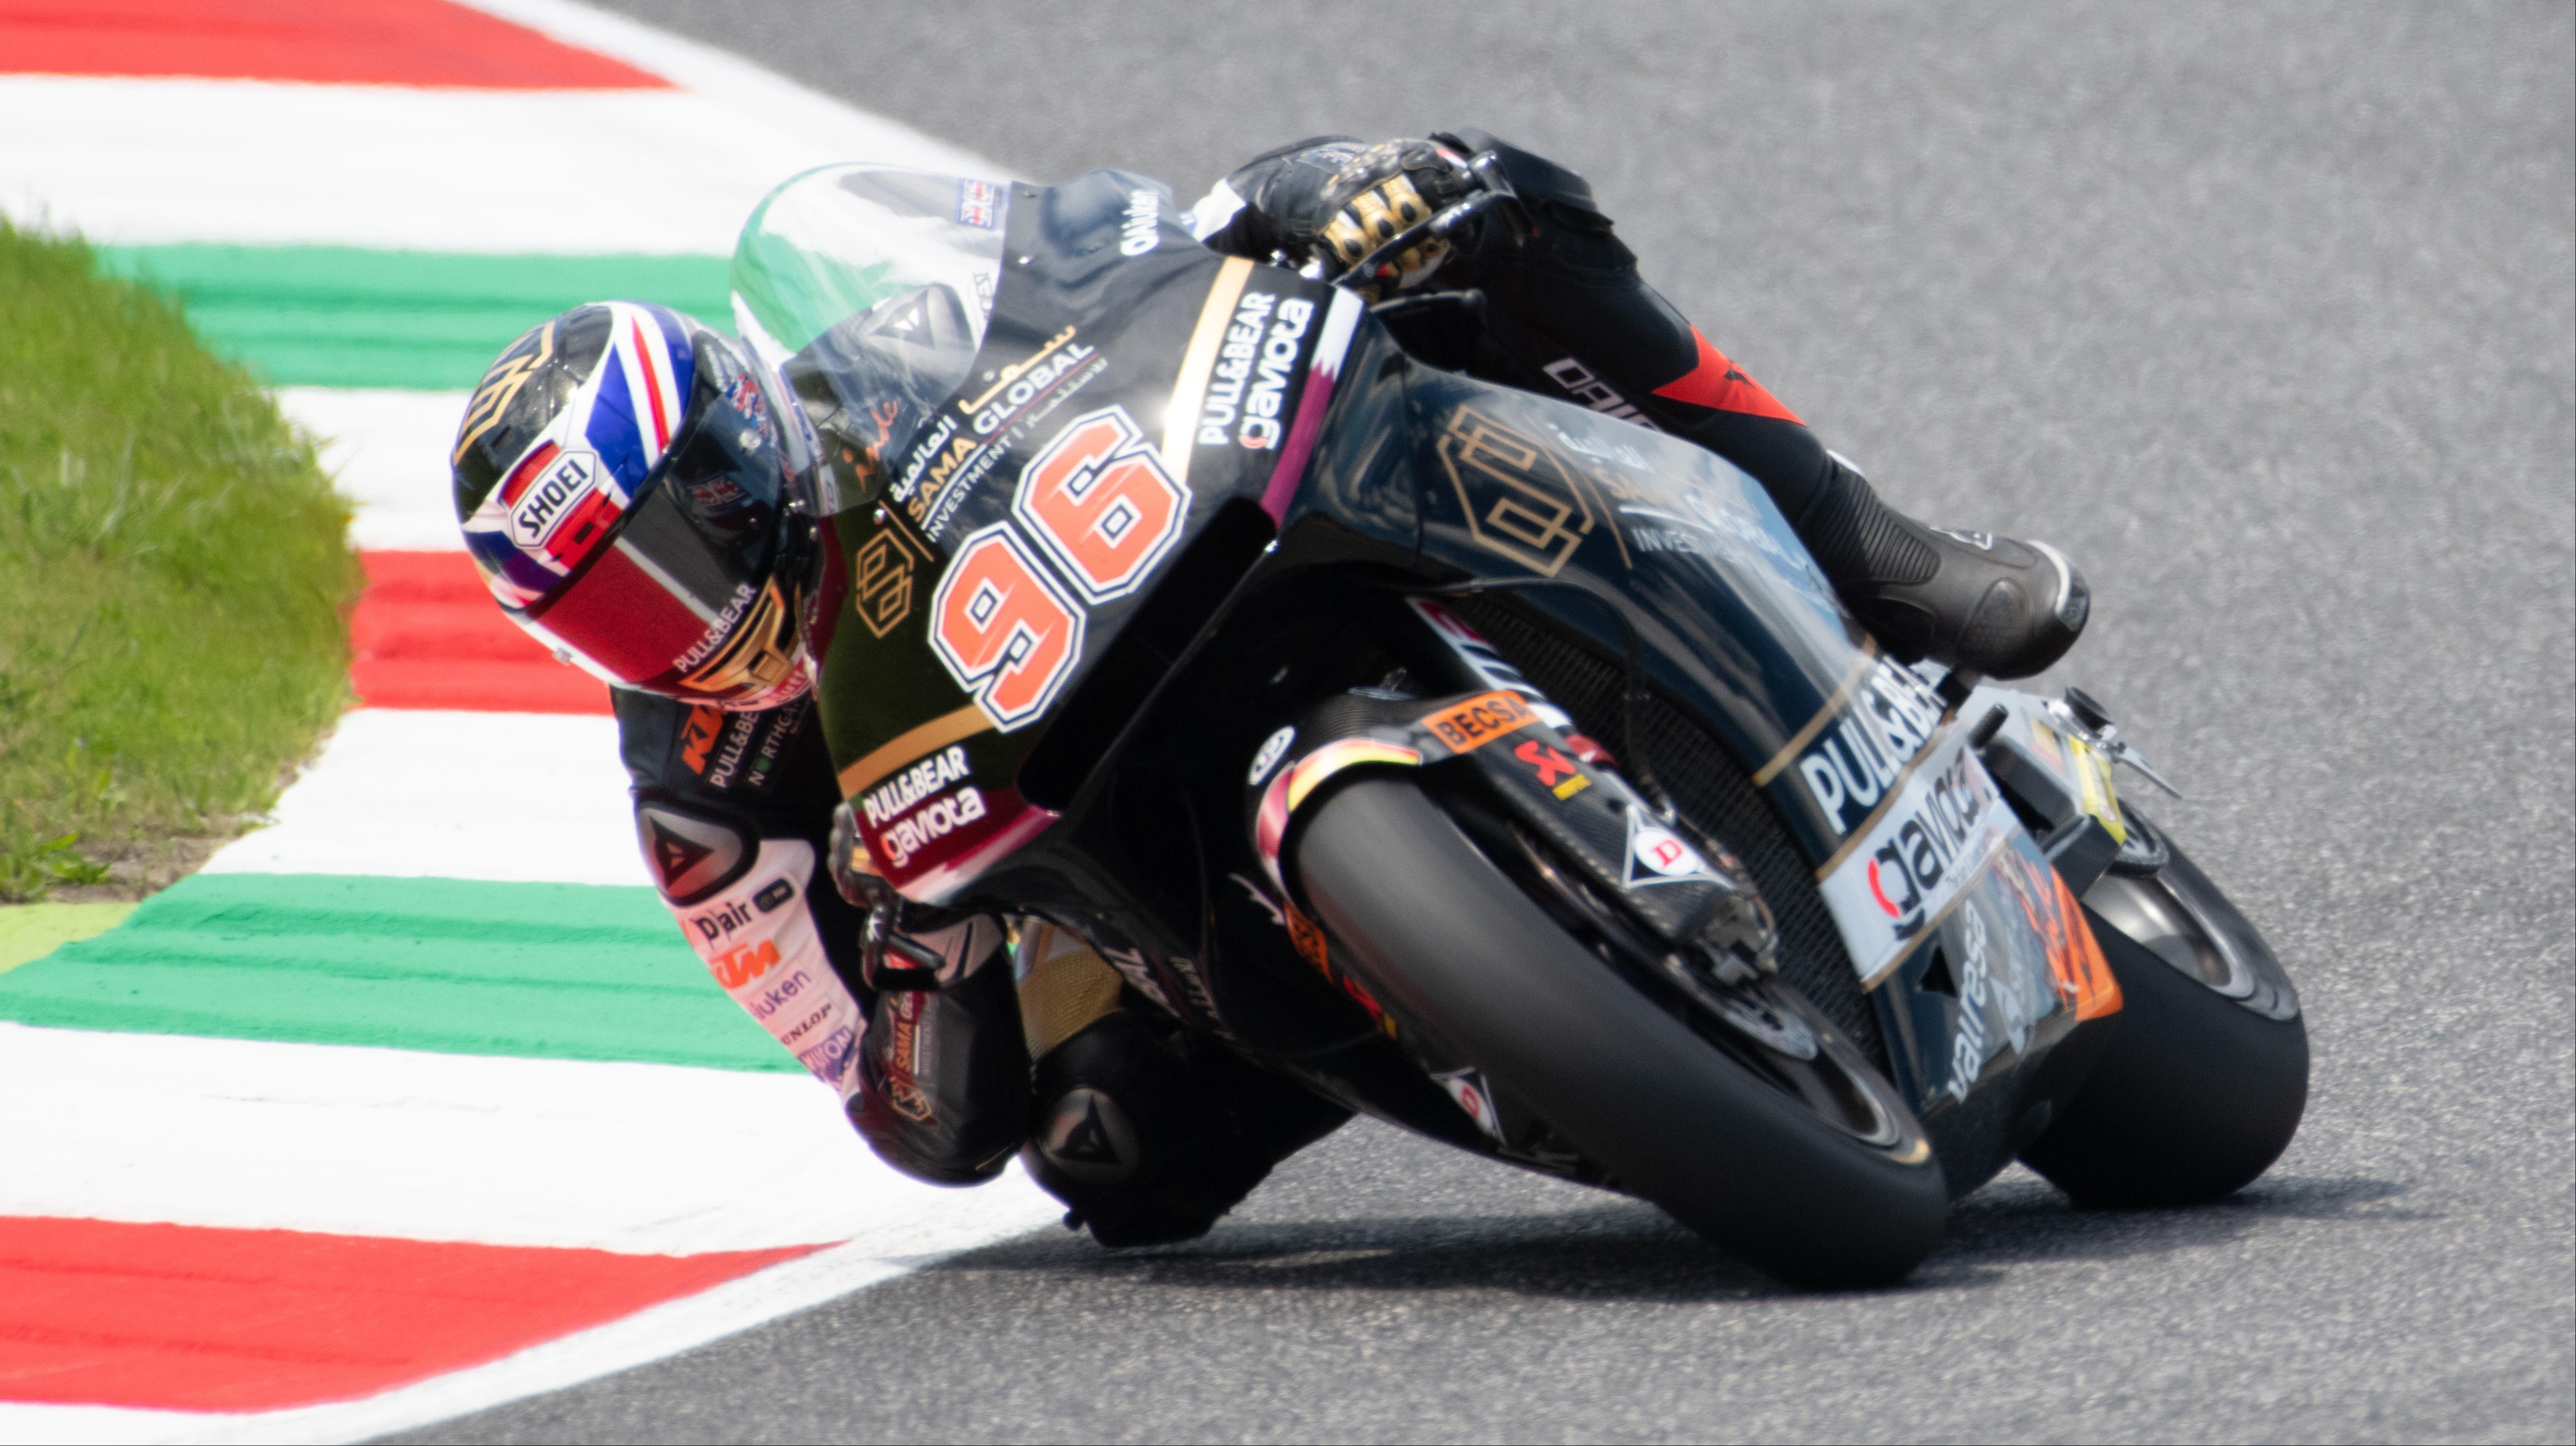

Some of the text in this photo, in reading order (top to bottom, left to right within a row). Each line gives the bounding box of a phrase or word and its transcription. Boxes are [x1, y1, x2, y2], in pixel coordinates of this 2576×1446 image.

[1198, 292, 1276, 444] PULL&BEAR
[1239, 297, 1315, 450] gaviota
[906, 343, 1095, 523] SAMA GLOBAL
[518, 458, 588, 539] SHOEI
[925, 435, 1012, 542] INVESTMENT
[928, 405, 1193, 734] 96
[672, 583, 757, 673] PULL&BEAR
[1435, 697, 1530, 746] BECSA
[863, 746, 970, 828] PULL&BEAR
[881, 786, 986, 868] gaviota
